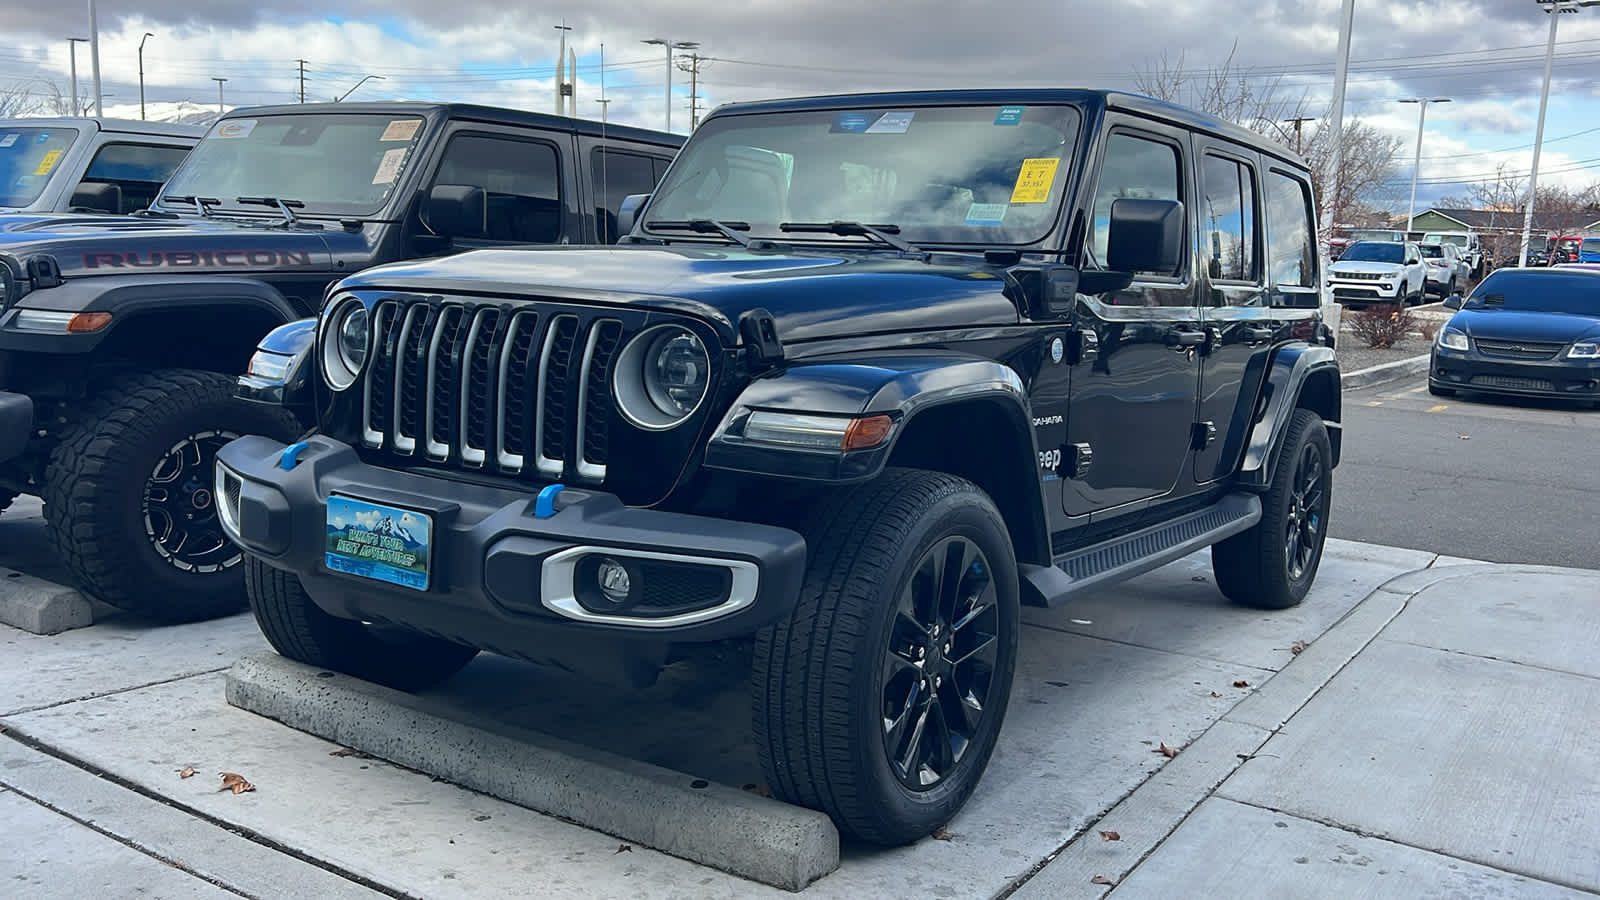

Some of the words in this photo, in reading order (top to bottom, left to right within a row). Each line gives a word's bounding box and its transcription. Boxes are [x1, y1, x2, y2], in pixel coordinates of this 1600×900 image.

[82, 250, 312, 268] RUBICON
[1039, 448, 1061, 471] eep
[348, 528, 379, 546] WHAT'S
[380, 535, 405, 551] YOUR
[336, 539, 360, 554] NEXT
[359, 544, 417, 566] ADVENTURE?
